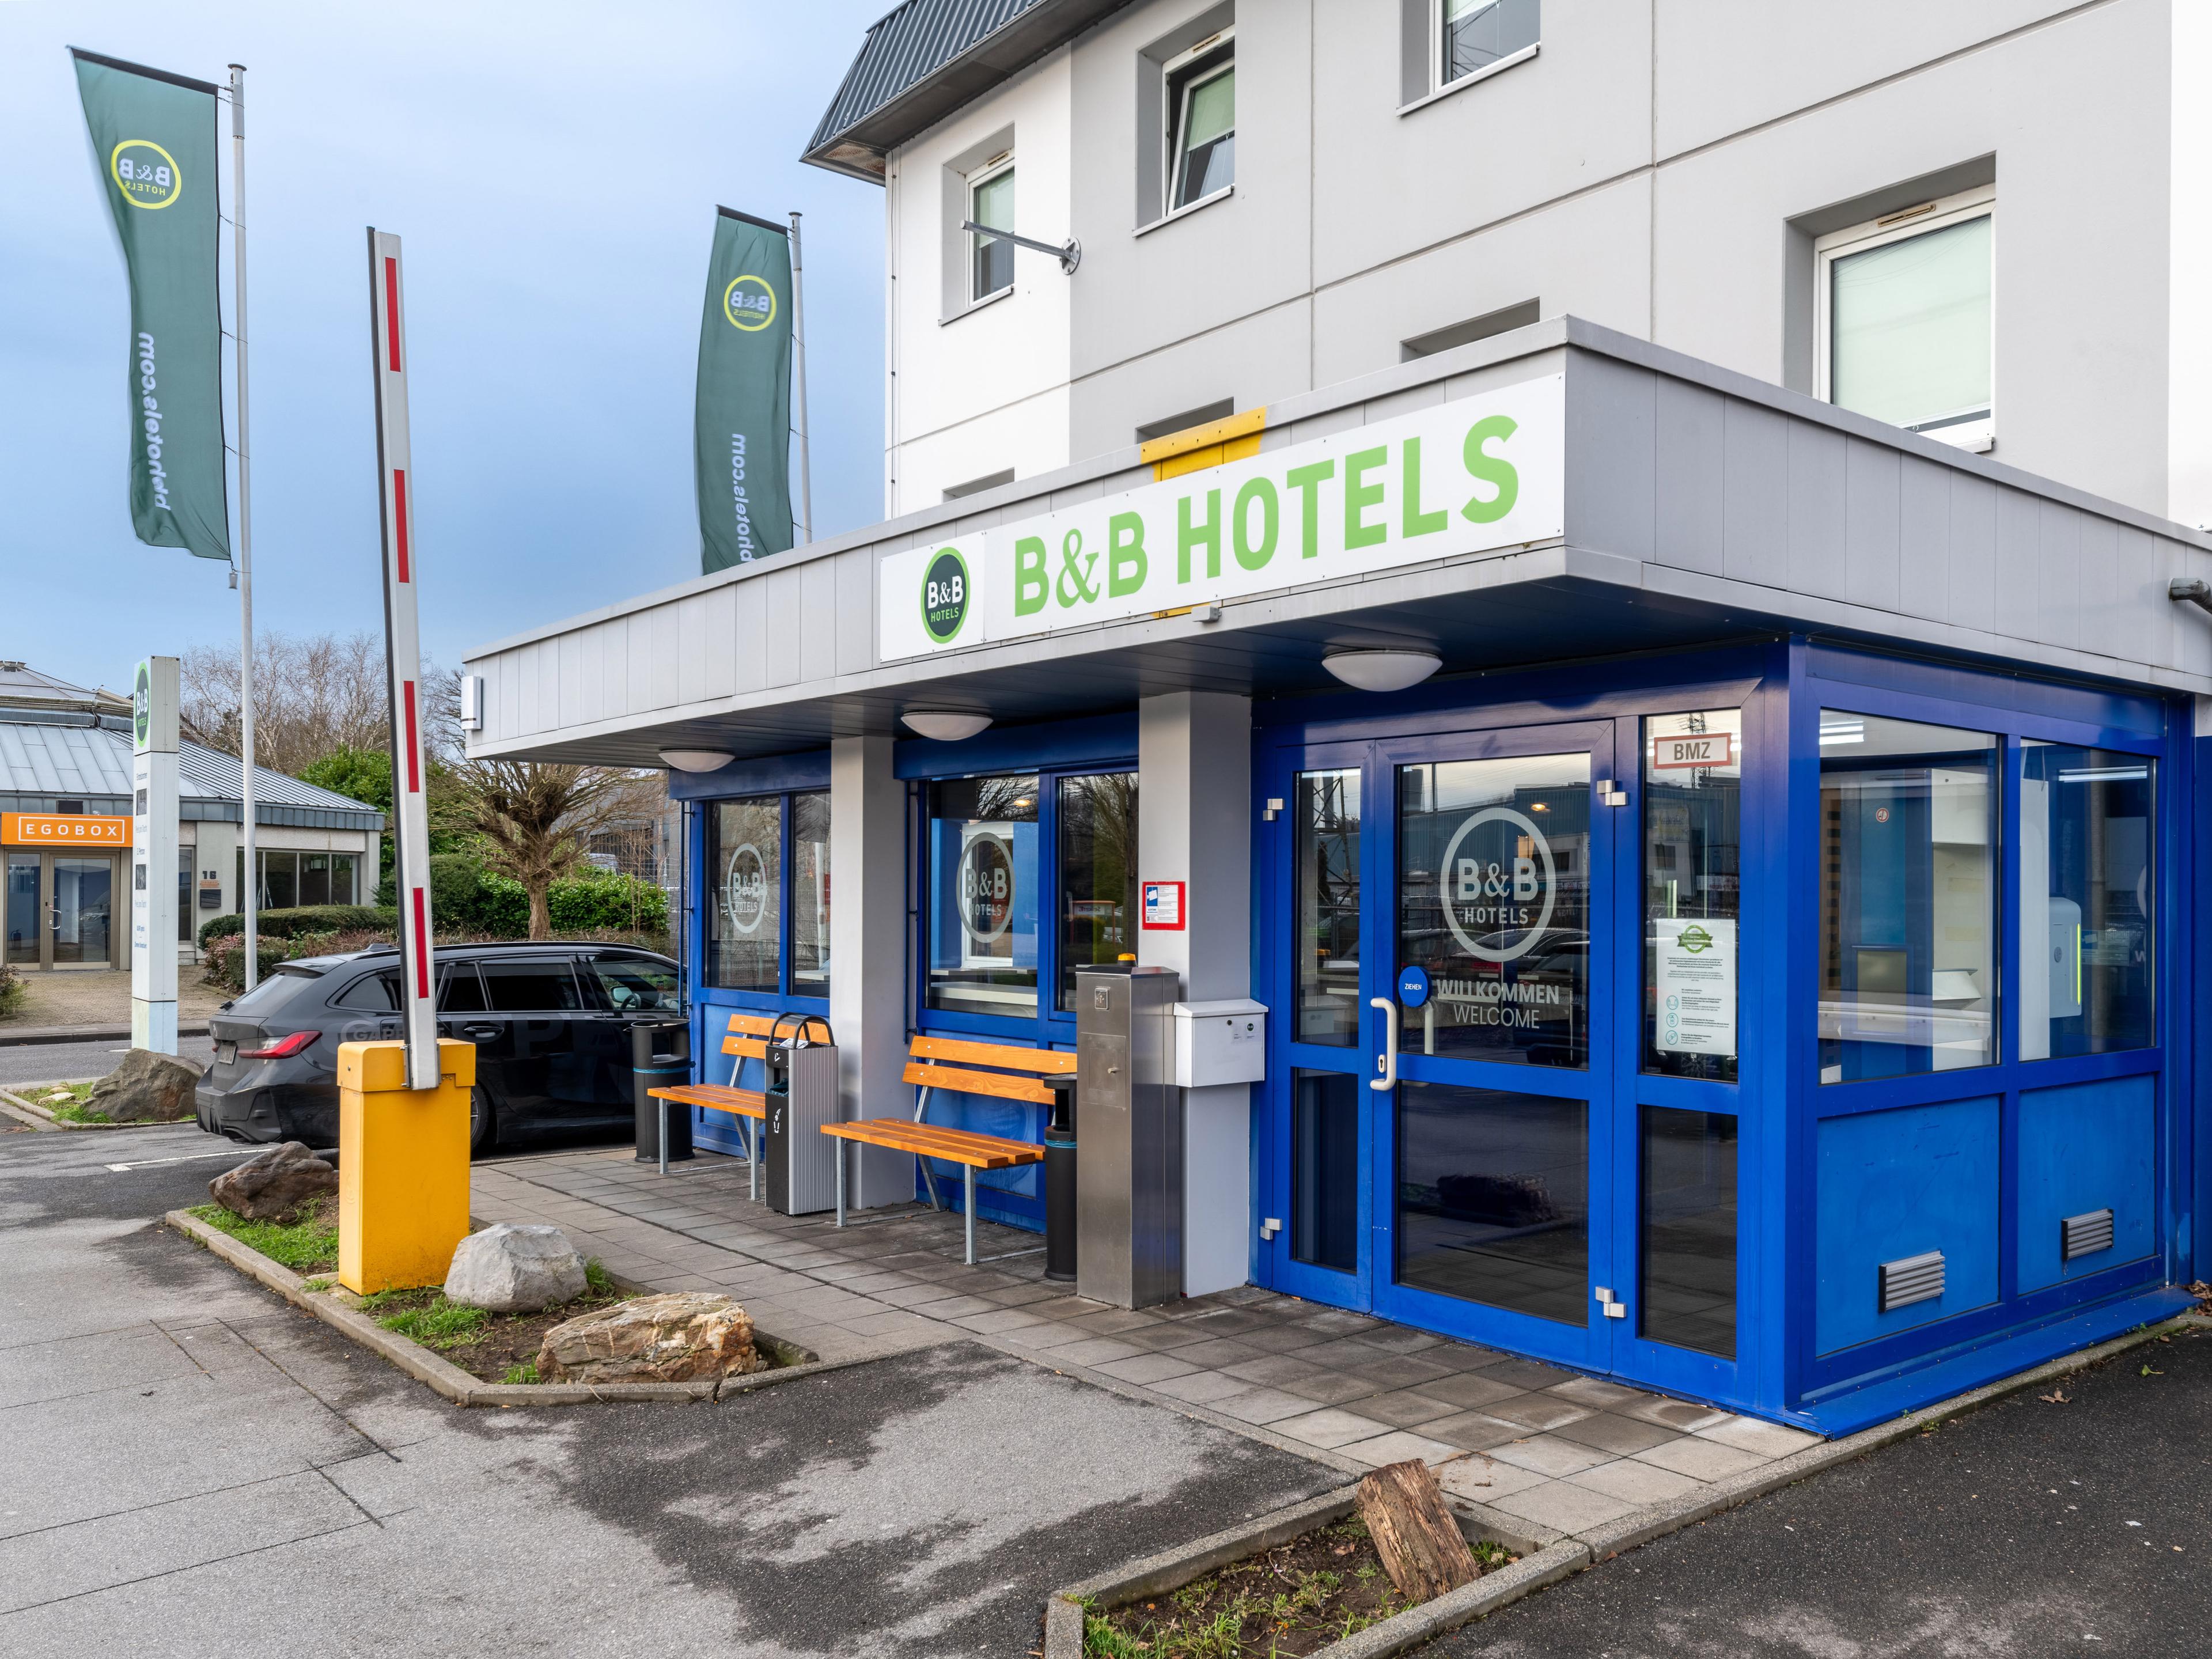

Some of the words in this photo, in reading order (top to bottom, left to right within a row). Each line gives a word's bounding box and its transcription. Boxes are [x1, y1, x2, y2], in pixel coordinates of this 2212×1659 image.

[1014, 511, 1148, 618] B&B
[1177, 414, 1520, 585] HOTELS
[927, 575, 964, 609] B&B
[931, 607, 960, 623] HOTELS
[137, 688, 148, 716] B&B
[1674, 741, 1711, 761] BMZ
[26, 823, 118, 836] EGOBOX
[733, 872, 761, 897] B&B
[965, 868, 1007, 899] B&B
[1458, 857, 1539, 901] B&B
[736, 902, 758, 912] HOTELS
[969, 904, 1002, 916] HOTELS
[1464, 907, 1529, 925] HOTELS
[1436, 979, 1560, 1005] WILLKOMMEN
[1453, 1005, 1540, 1029] WELCOME
